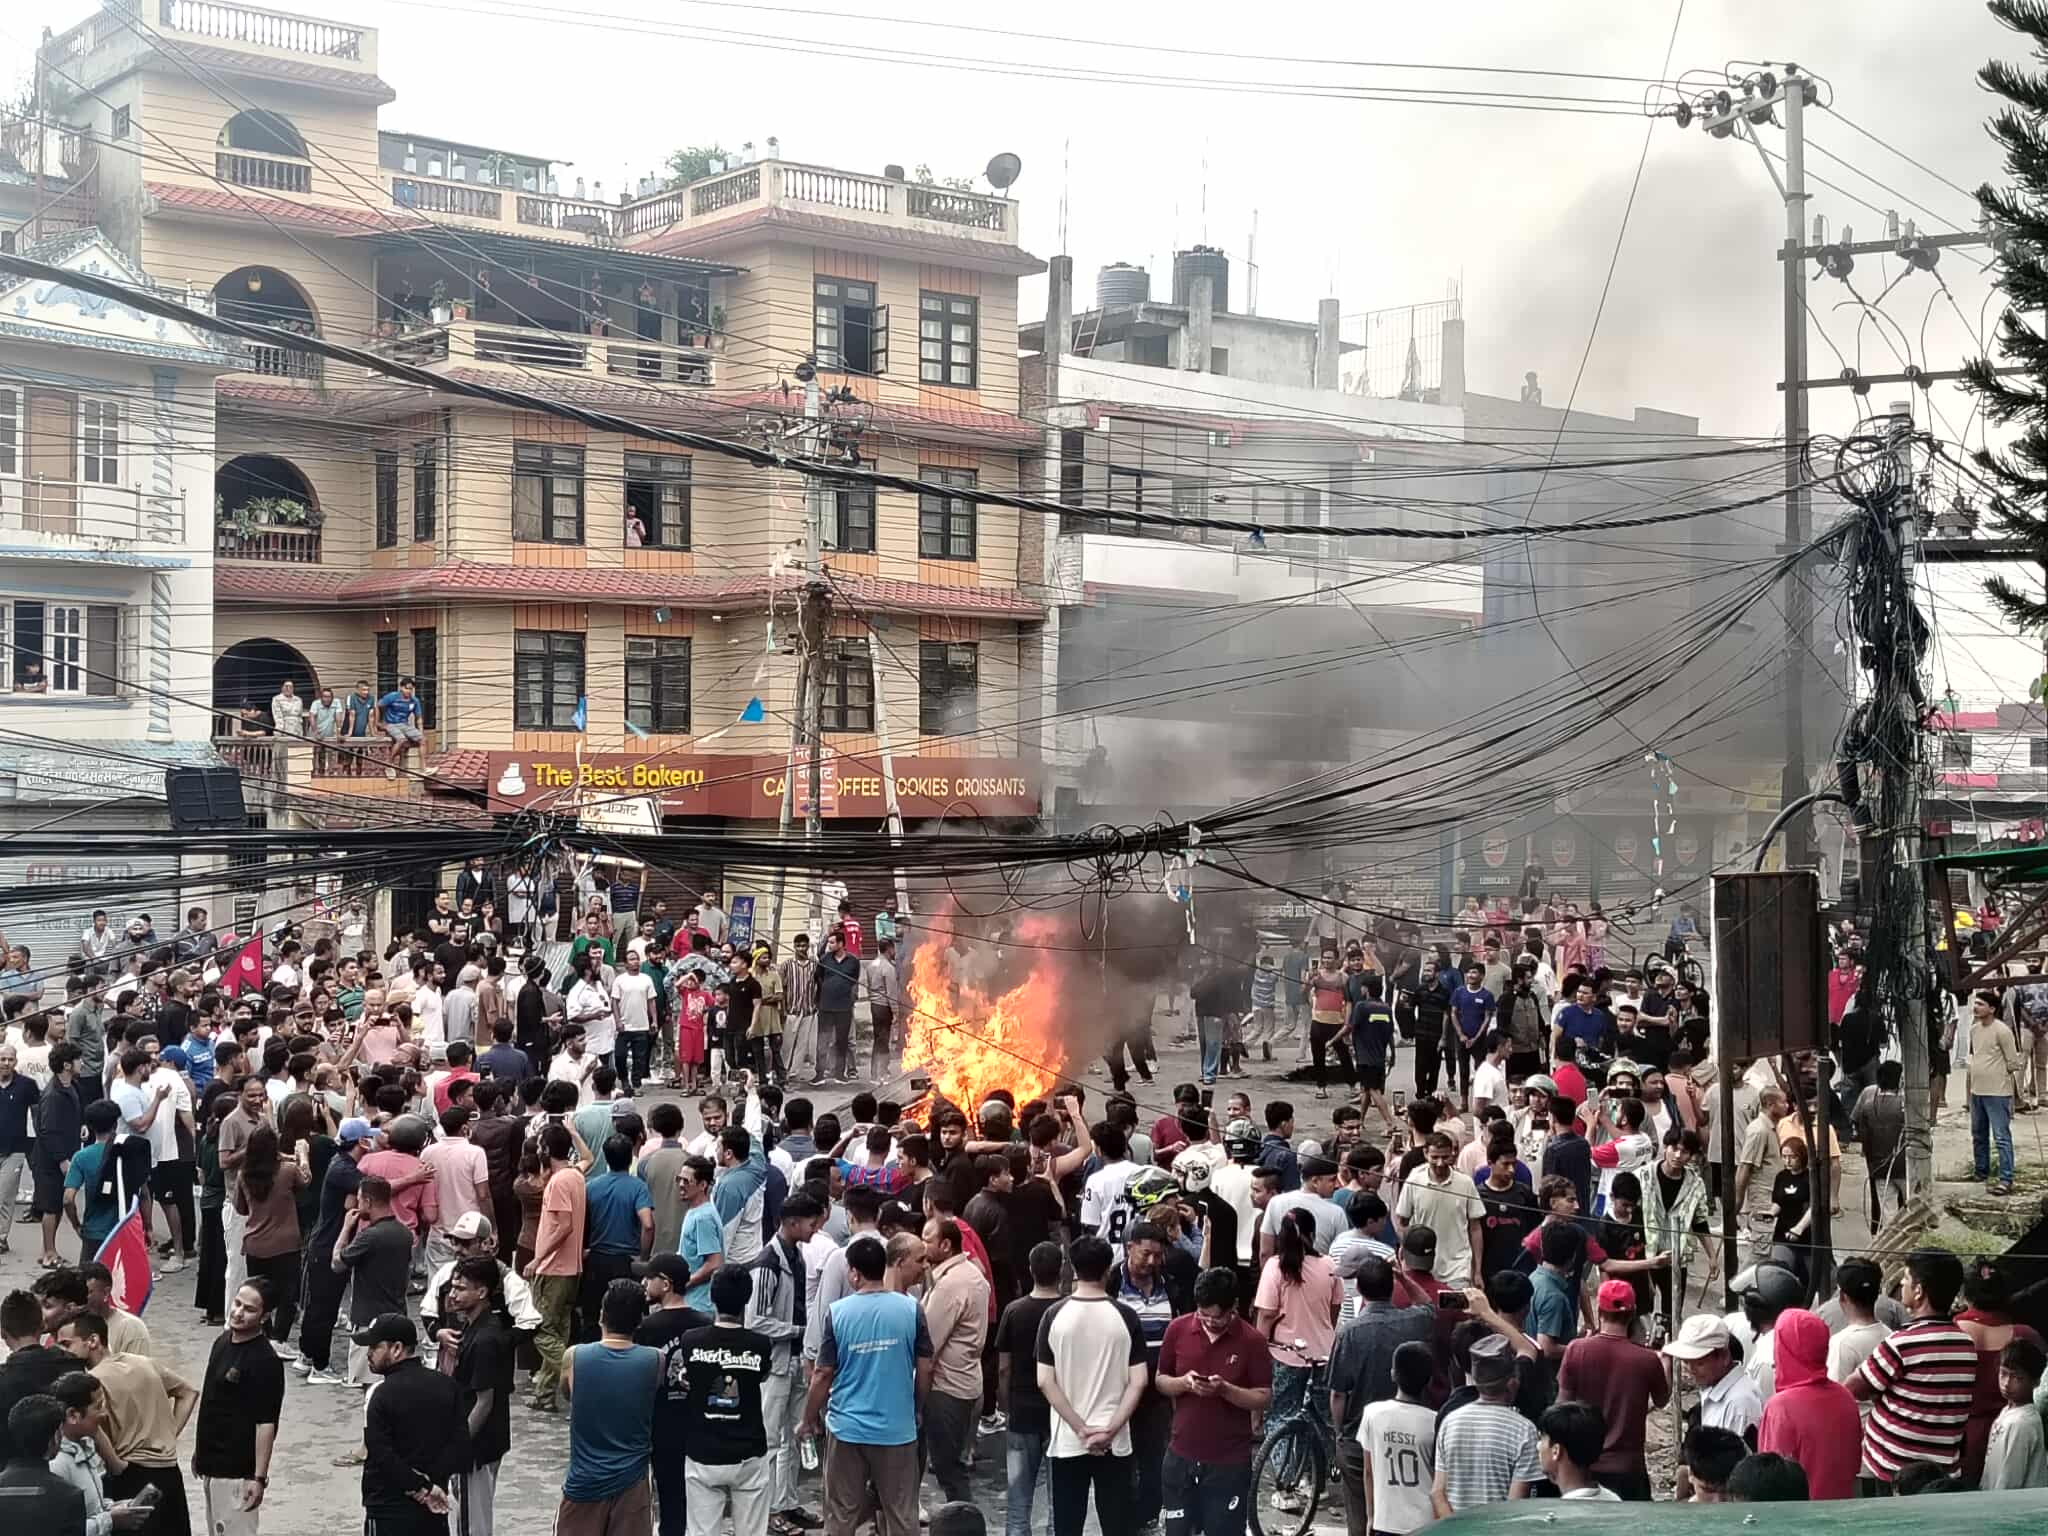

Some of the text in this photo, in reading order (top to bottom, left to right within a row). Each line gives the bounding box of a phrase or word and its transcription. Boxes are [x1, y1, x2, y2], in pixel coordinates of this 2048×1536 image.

[532, 763, 704, 791] The Best Bakery
[762, 777, 786, 796] CA
[837, 777, 880, 796] OFFEE
[895, 777, 949, 796] OOKIES
[955, 777, 1026, 797] CROISSANTS
[1109, 1209, 1135, 1243] 8
[1383, 1431, 1416, 1446] MESSI
[1384, 1447, 1419, 1487] 10
